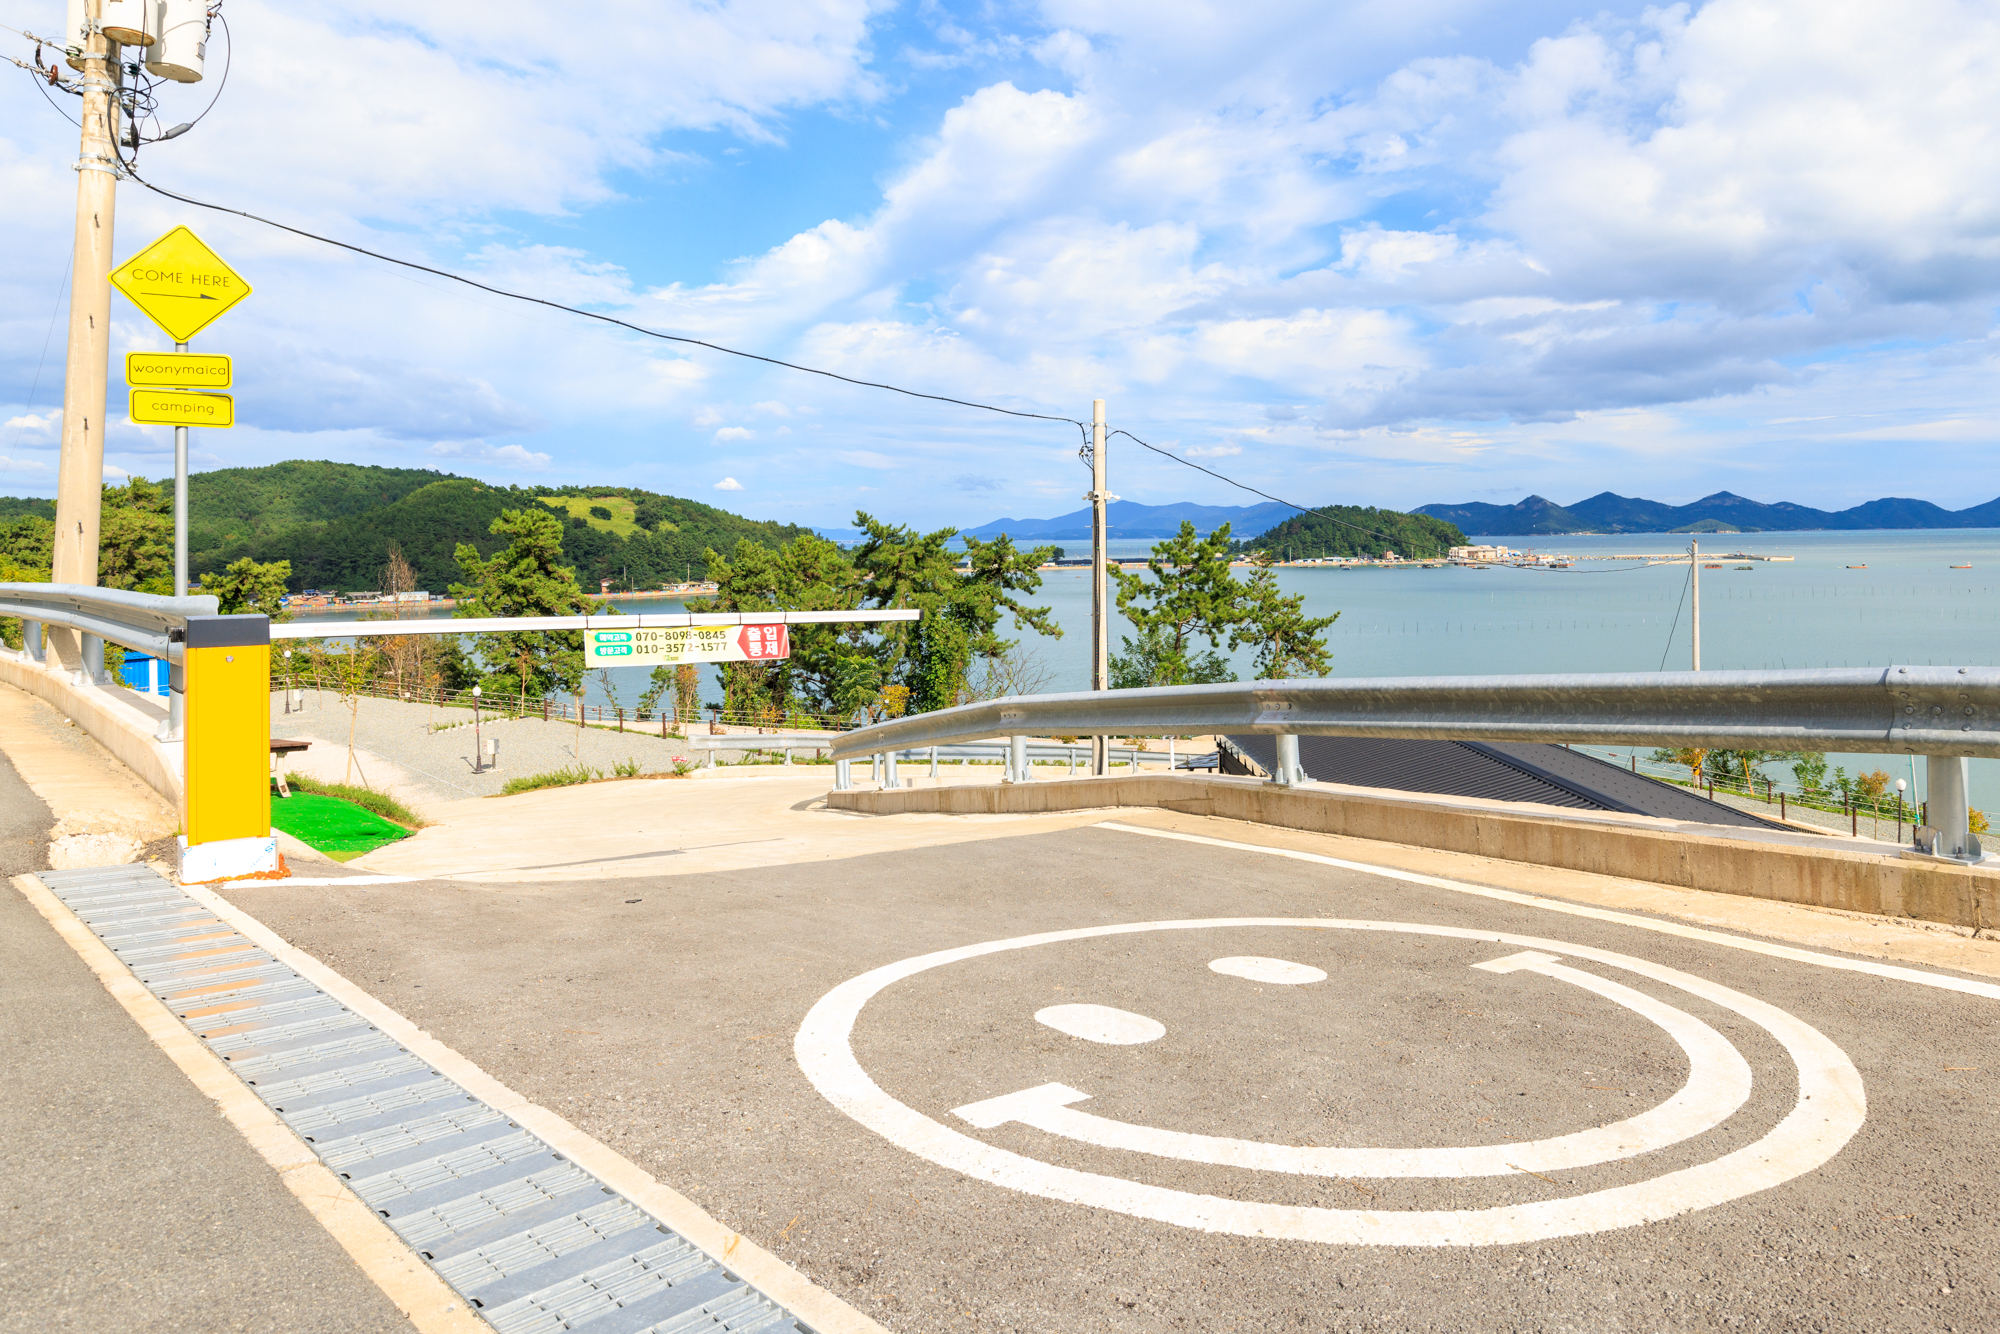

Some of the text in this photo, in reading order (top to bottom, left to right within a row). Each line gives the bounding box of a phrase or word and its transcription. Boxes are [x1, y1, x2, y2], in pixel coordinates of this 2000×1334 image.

[132, 268, 231, 288] COME HERE
[133, 365, 226, 376] woonymaica
[152, 402, 214, 416] camping
[599, 630, 726, 642] 예약고객 070-8098-0845
[747, 626, 777, 641] 출입
[599, 641, 728, 655] 방문고객 010-3572-1577
[749, 641, 778, 657] 통제
